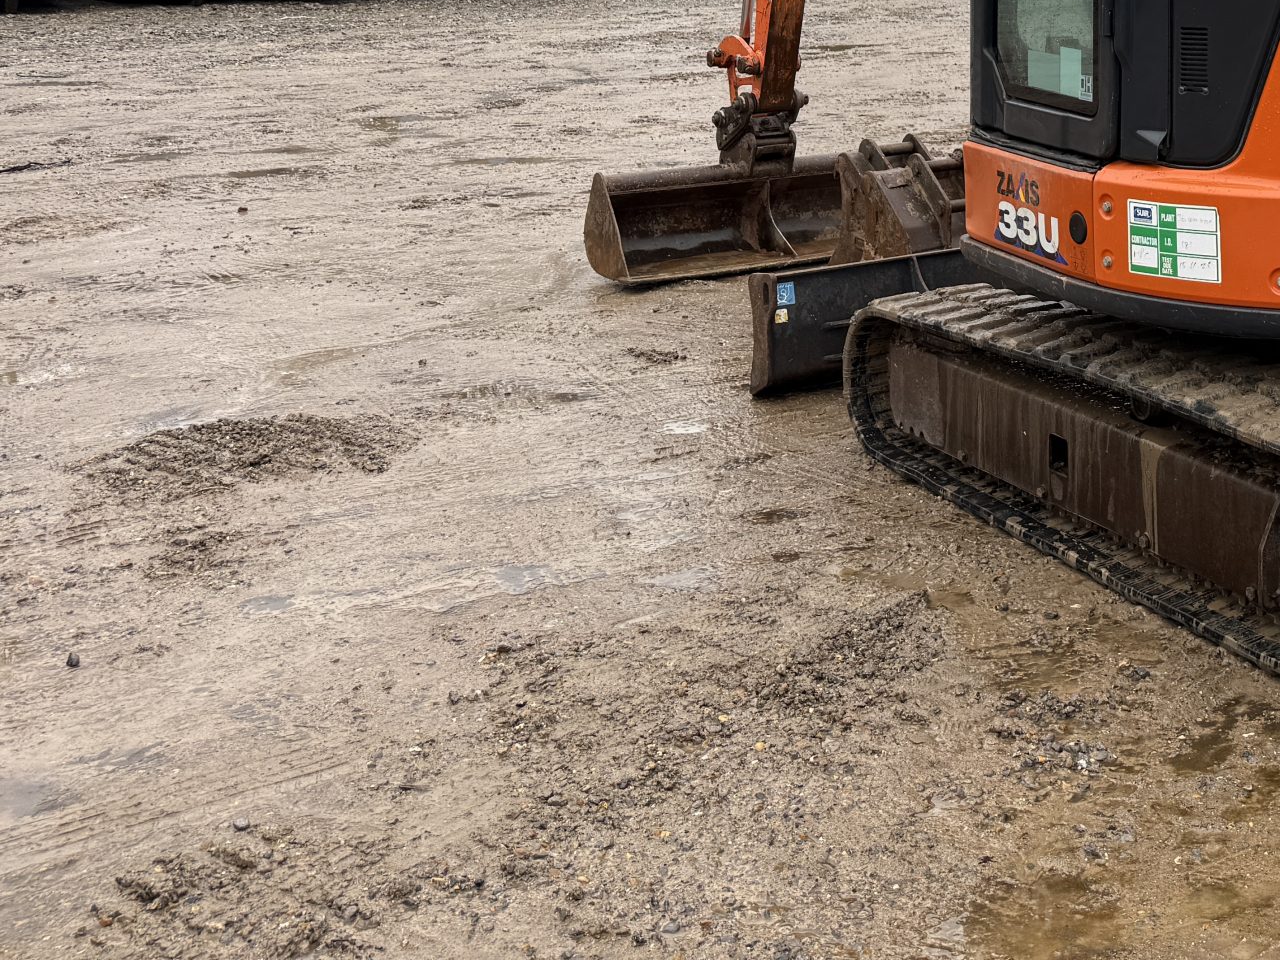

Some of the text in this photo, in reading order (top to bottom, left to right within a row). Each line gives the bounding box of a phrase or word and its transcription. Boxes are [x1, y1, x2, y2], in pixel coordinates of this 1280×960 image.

[996, 170, 1040, 207] ZAXIS
[1160, 213, 1176, 223] PLANT
[998, 200, 1060, 254] 33U
[1131, 234, 1158, 246] CONTRACTOR
[1161, 267, 1174, 275] DATE
